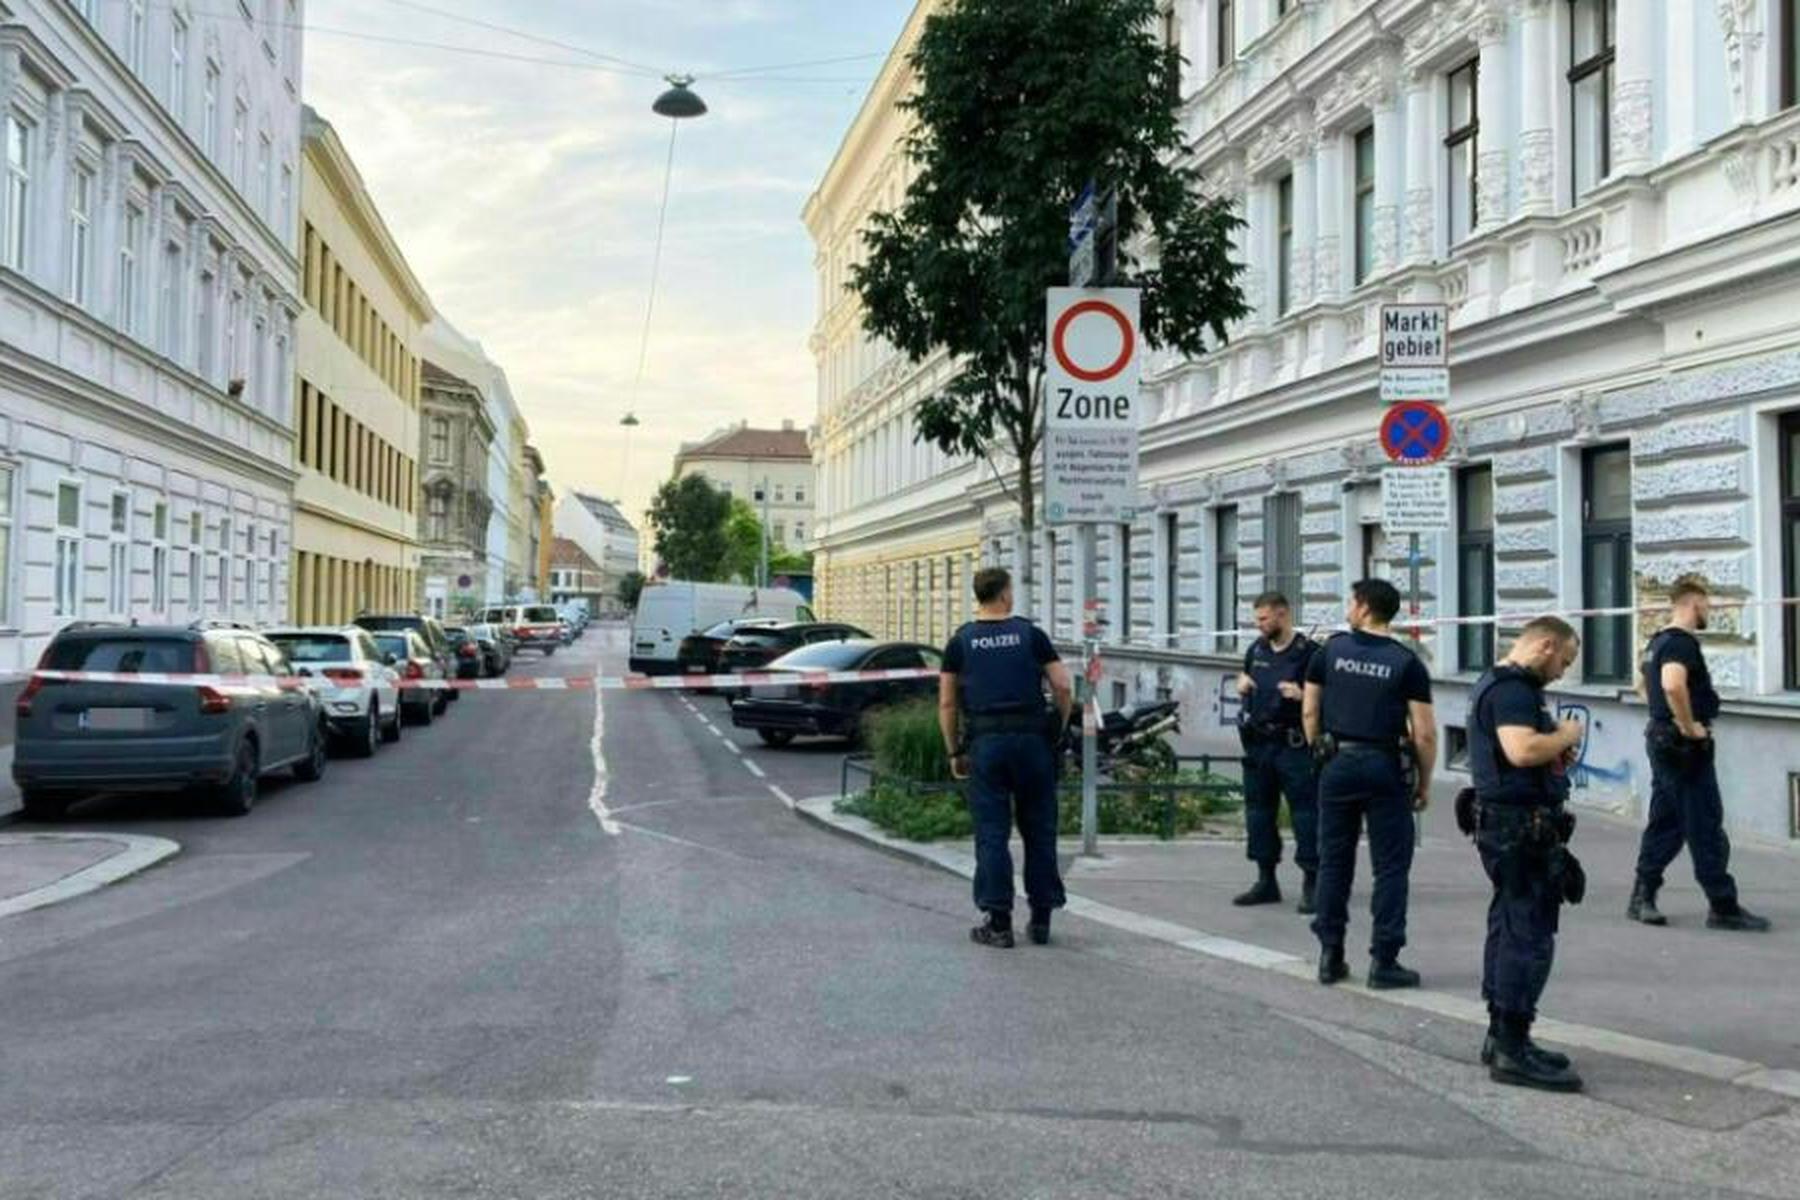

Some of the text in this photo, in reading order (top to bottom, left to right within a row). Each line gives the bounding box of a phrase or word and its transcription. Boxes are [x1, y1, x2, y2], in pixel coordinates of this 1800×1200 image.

[1385, 311, 1443, 331] Markt-
[1385, 335, 1441, 362] gebiet
[1057, 388, 1129, 419] Zone
[971, 634, 1020, 649] POLIZEI
[1335, 658, 1391, 678] POLIZEI
